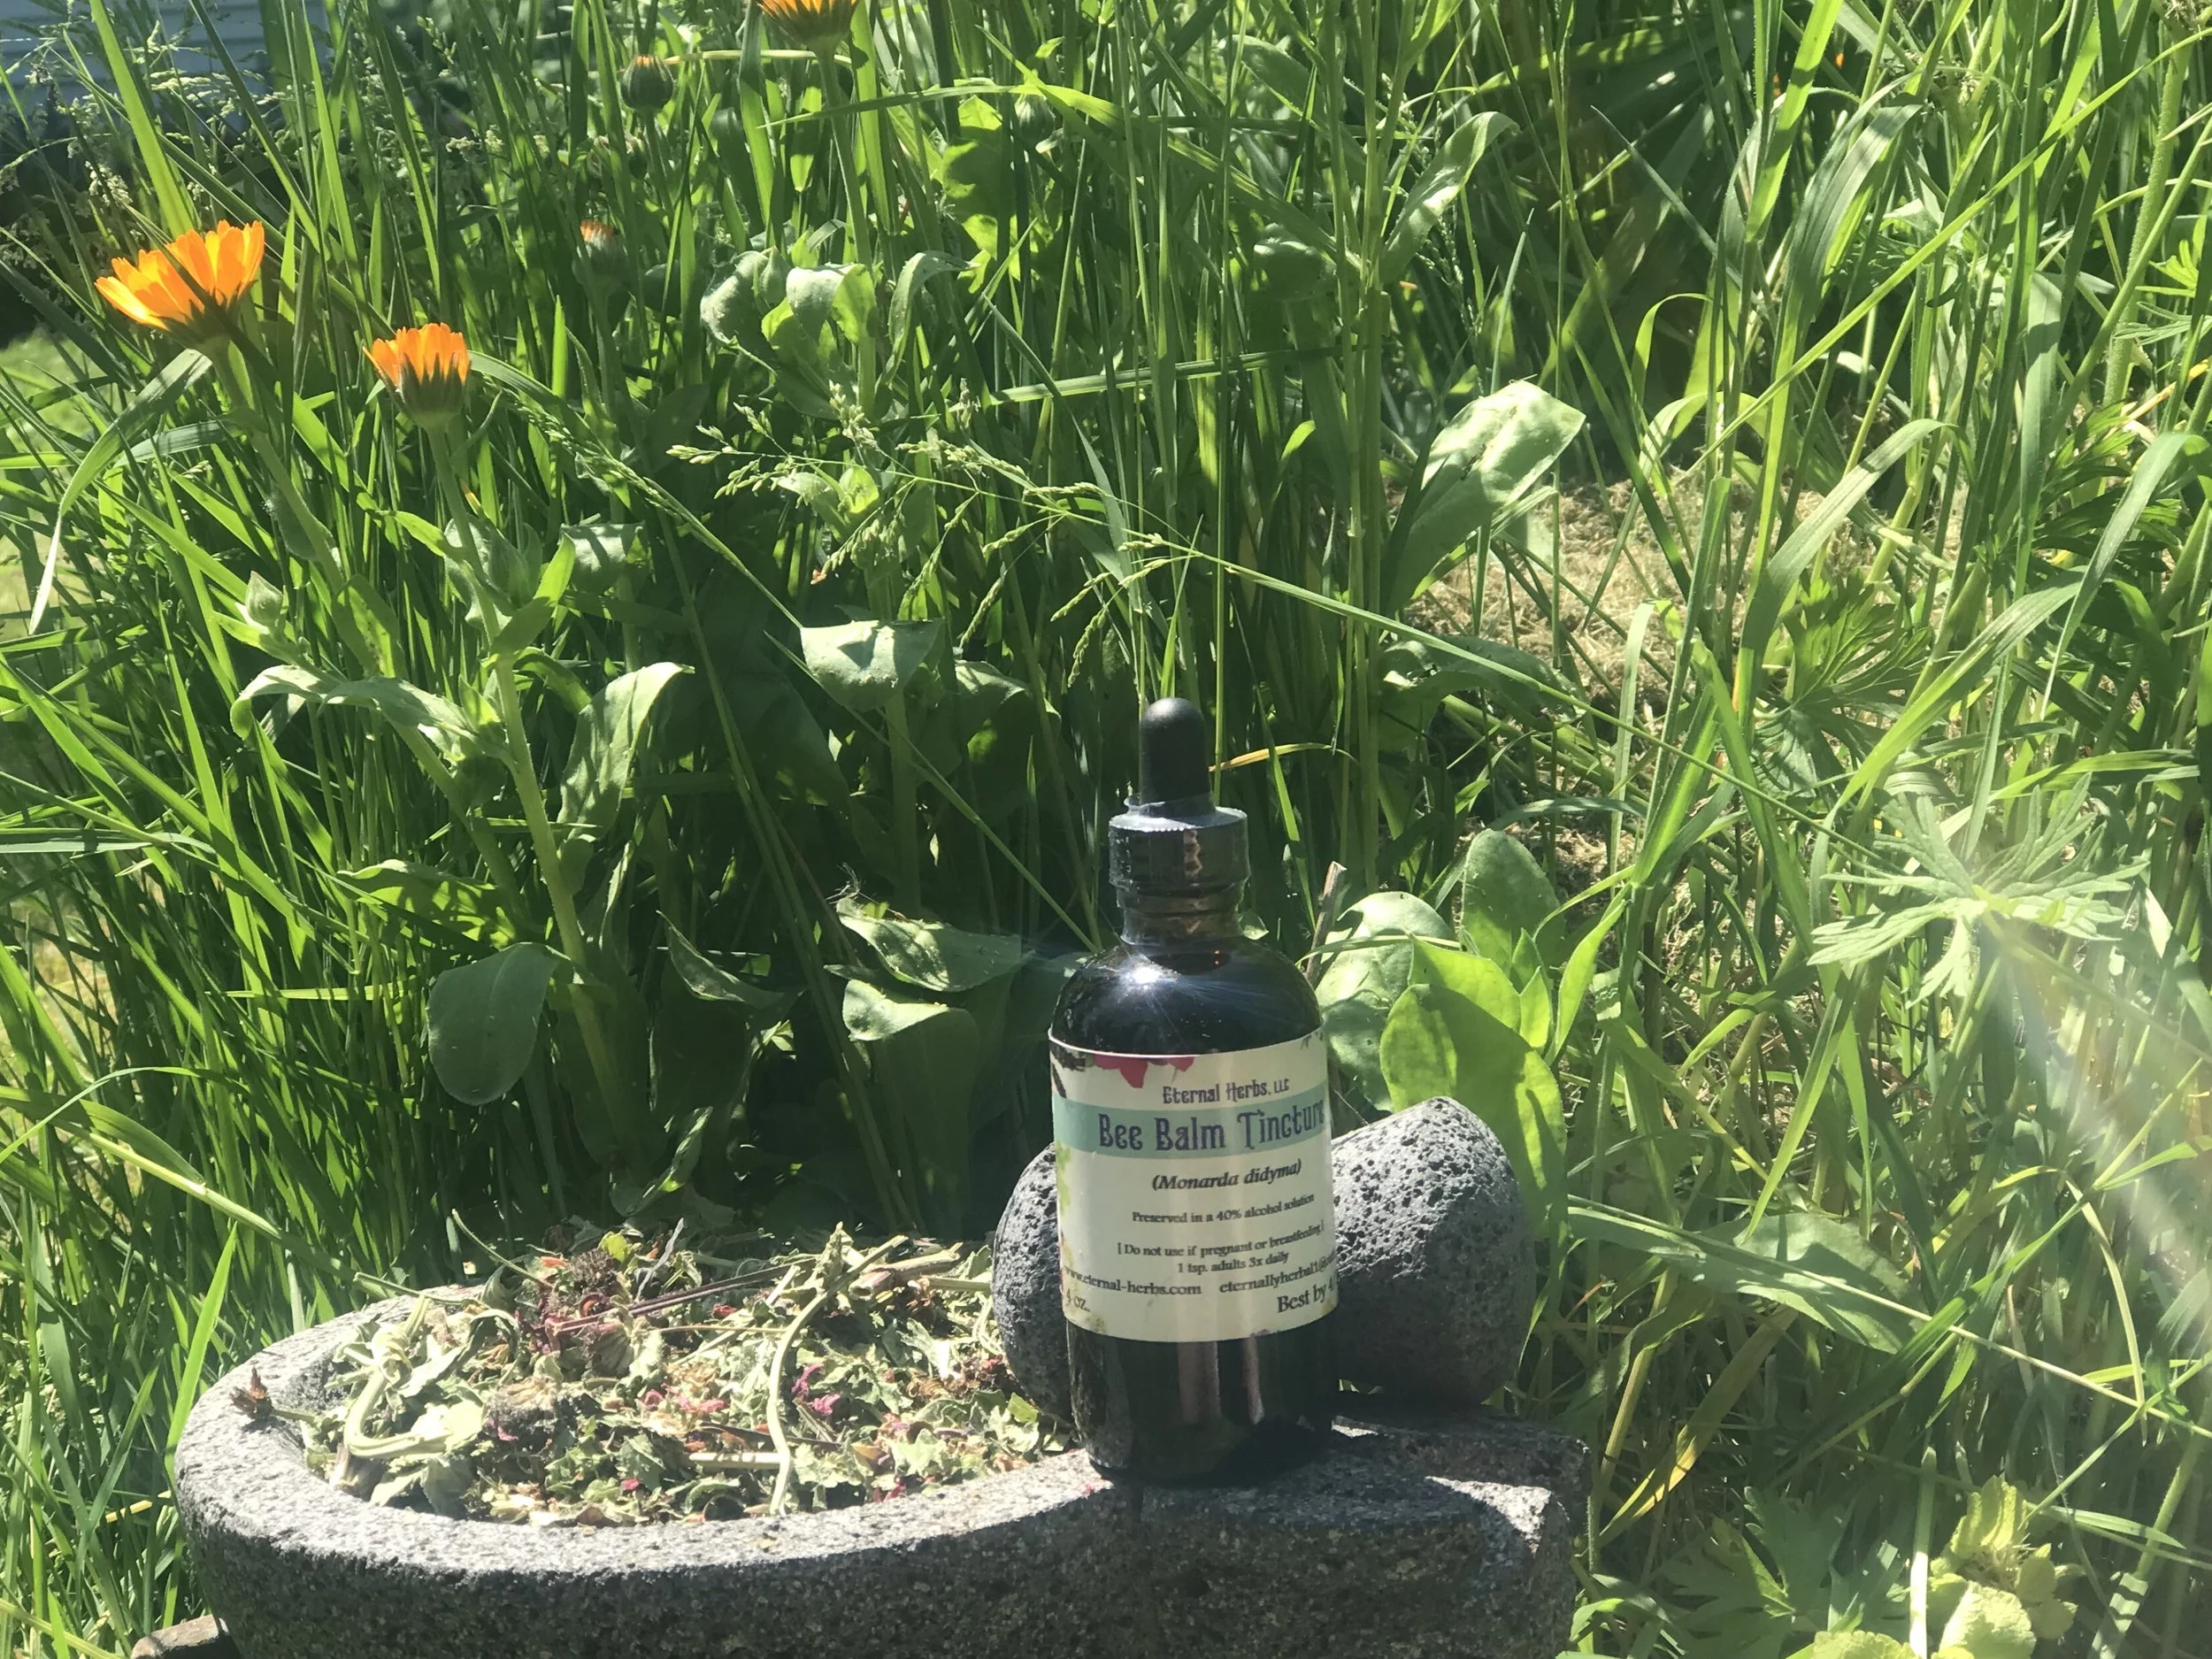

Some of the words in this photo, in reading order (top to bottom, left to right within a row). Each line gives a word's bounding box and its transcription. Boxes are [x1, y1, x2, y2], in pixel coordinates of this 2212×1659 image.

[1162, 1084, 1220, 1104] Eternal
[1274, 1078, 1290, 1094] LLC
[1098, 1113, 1144, 1150] Bee
[1154, 1117, 1226, 1151] Balm
[1152, 1171, 1240, 1192] (Monarda
[1243, 1158, 1302, 1186] didyma)
[1133, 1211, 1188, 1223] Preserved
[1191, 1212, 1204, 1223] in
[1206, 1213, 1214, 1222] a
[1216, 1209, 1242, 1221] 40%
[1244, 1201, 1282, 1218] alcohol
[1284, 1193, 1316, 1211] solution
[1125, 1244, 1141, 1255] Do
[1143, 1246, 1162, 1256] not
[1164, 1248, 1185, 1256] use
[1187, 1245, 1197, 1256] if
[1200, 1241, 1253, 1258] pregnant
[1255, 1240, 1267, 1250] or
[1178, 1263, 1184, 1273] 1
[1187, 1263, 1208, 1275] tsp.
[1210, 1258, 1247, 1272] adults
[1248, 1256, 1263, 1268] 3x
[1265, 1251, 1289, 1264] daily
[1277, 1289, 1310, 1313] Best
[1312, 1283, 1327, 1303] by
